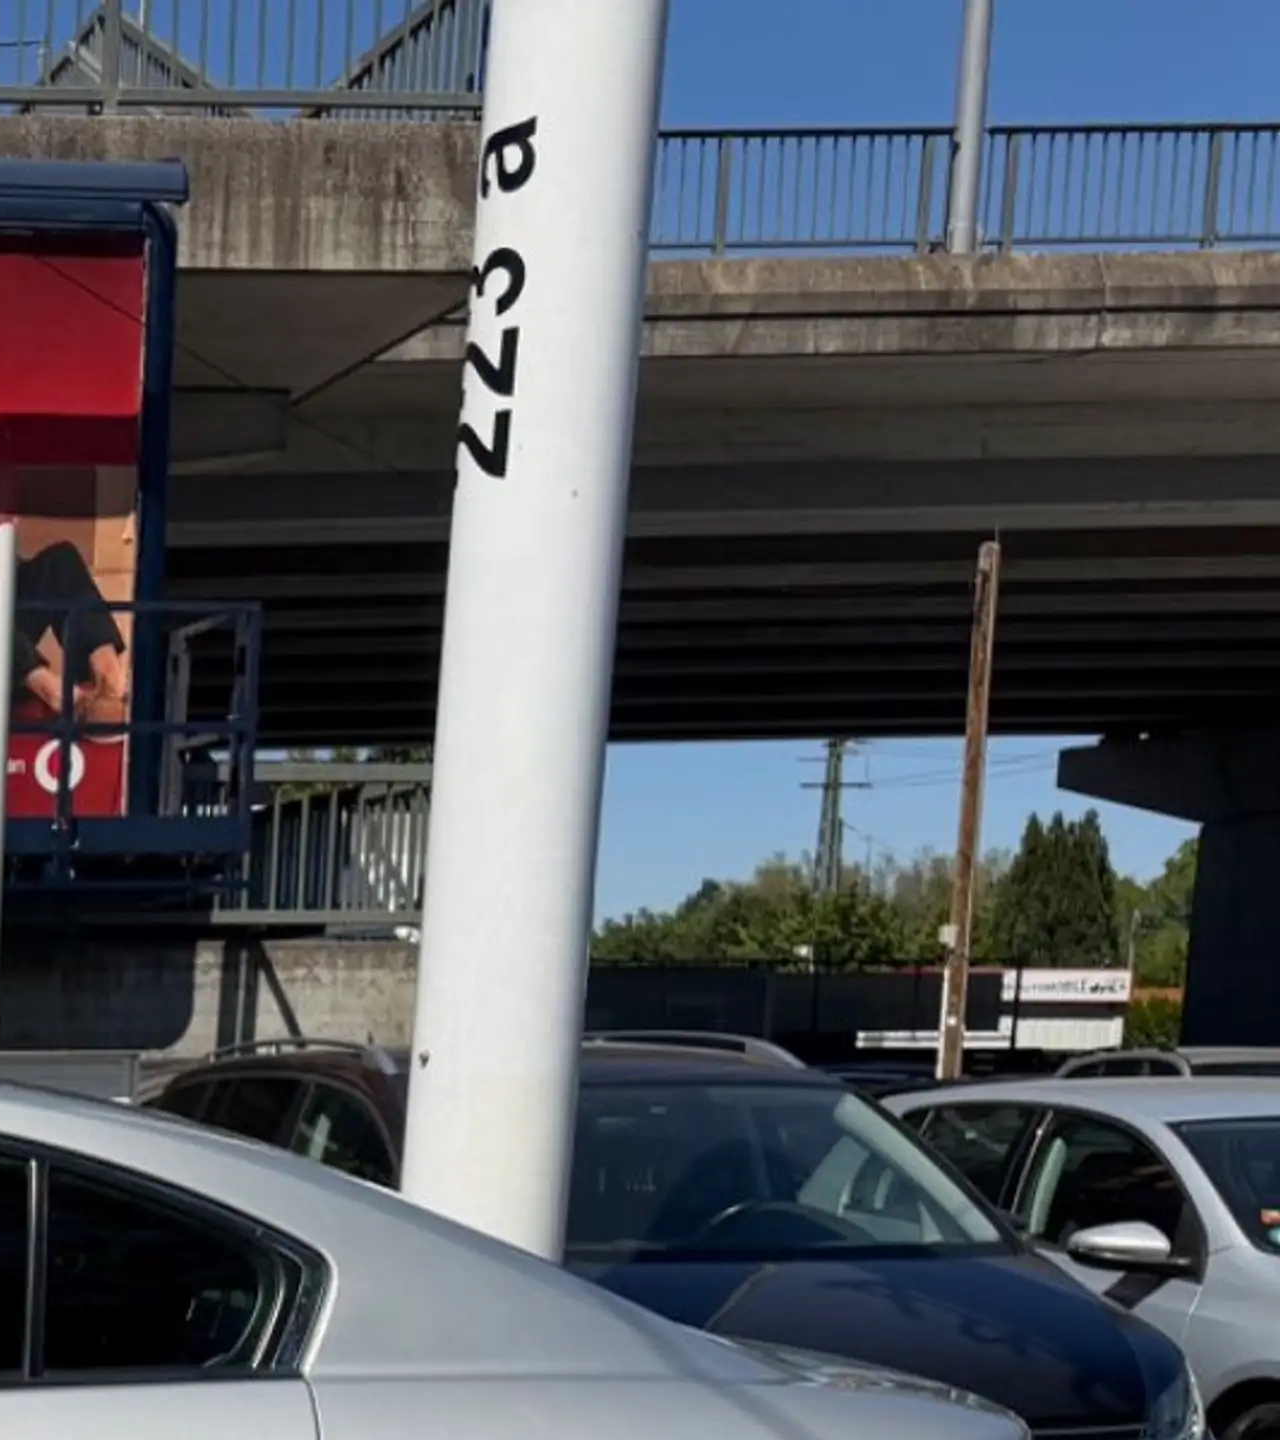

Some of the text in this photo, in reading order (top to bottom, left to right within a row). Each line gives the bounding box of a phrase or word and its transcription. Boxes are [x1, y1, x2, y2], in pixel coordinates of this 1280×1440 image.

[457, 115, 538, 478] 223 a
[6, 757, 27, 776] an
